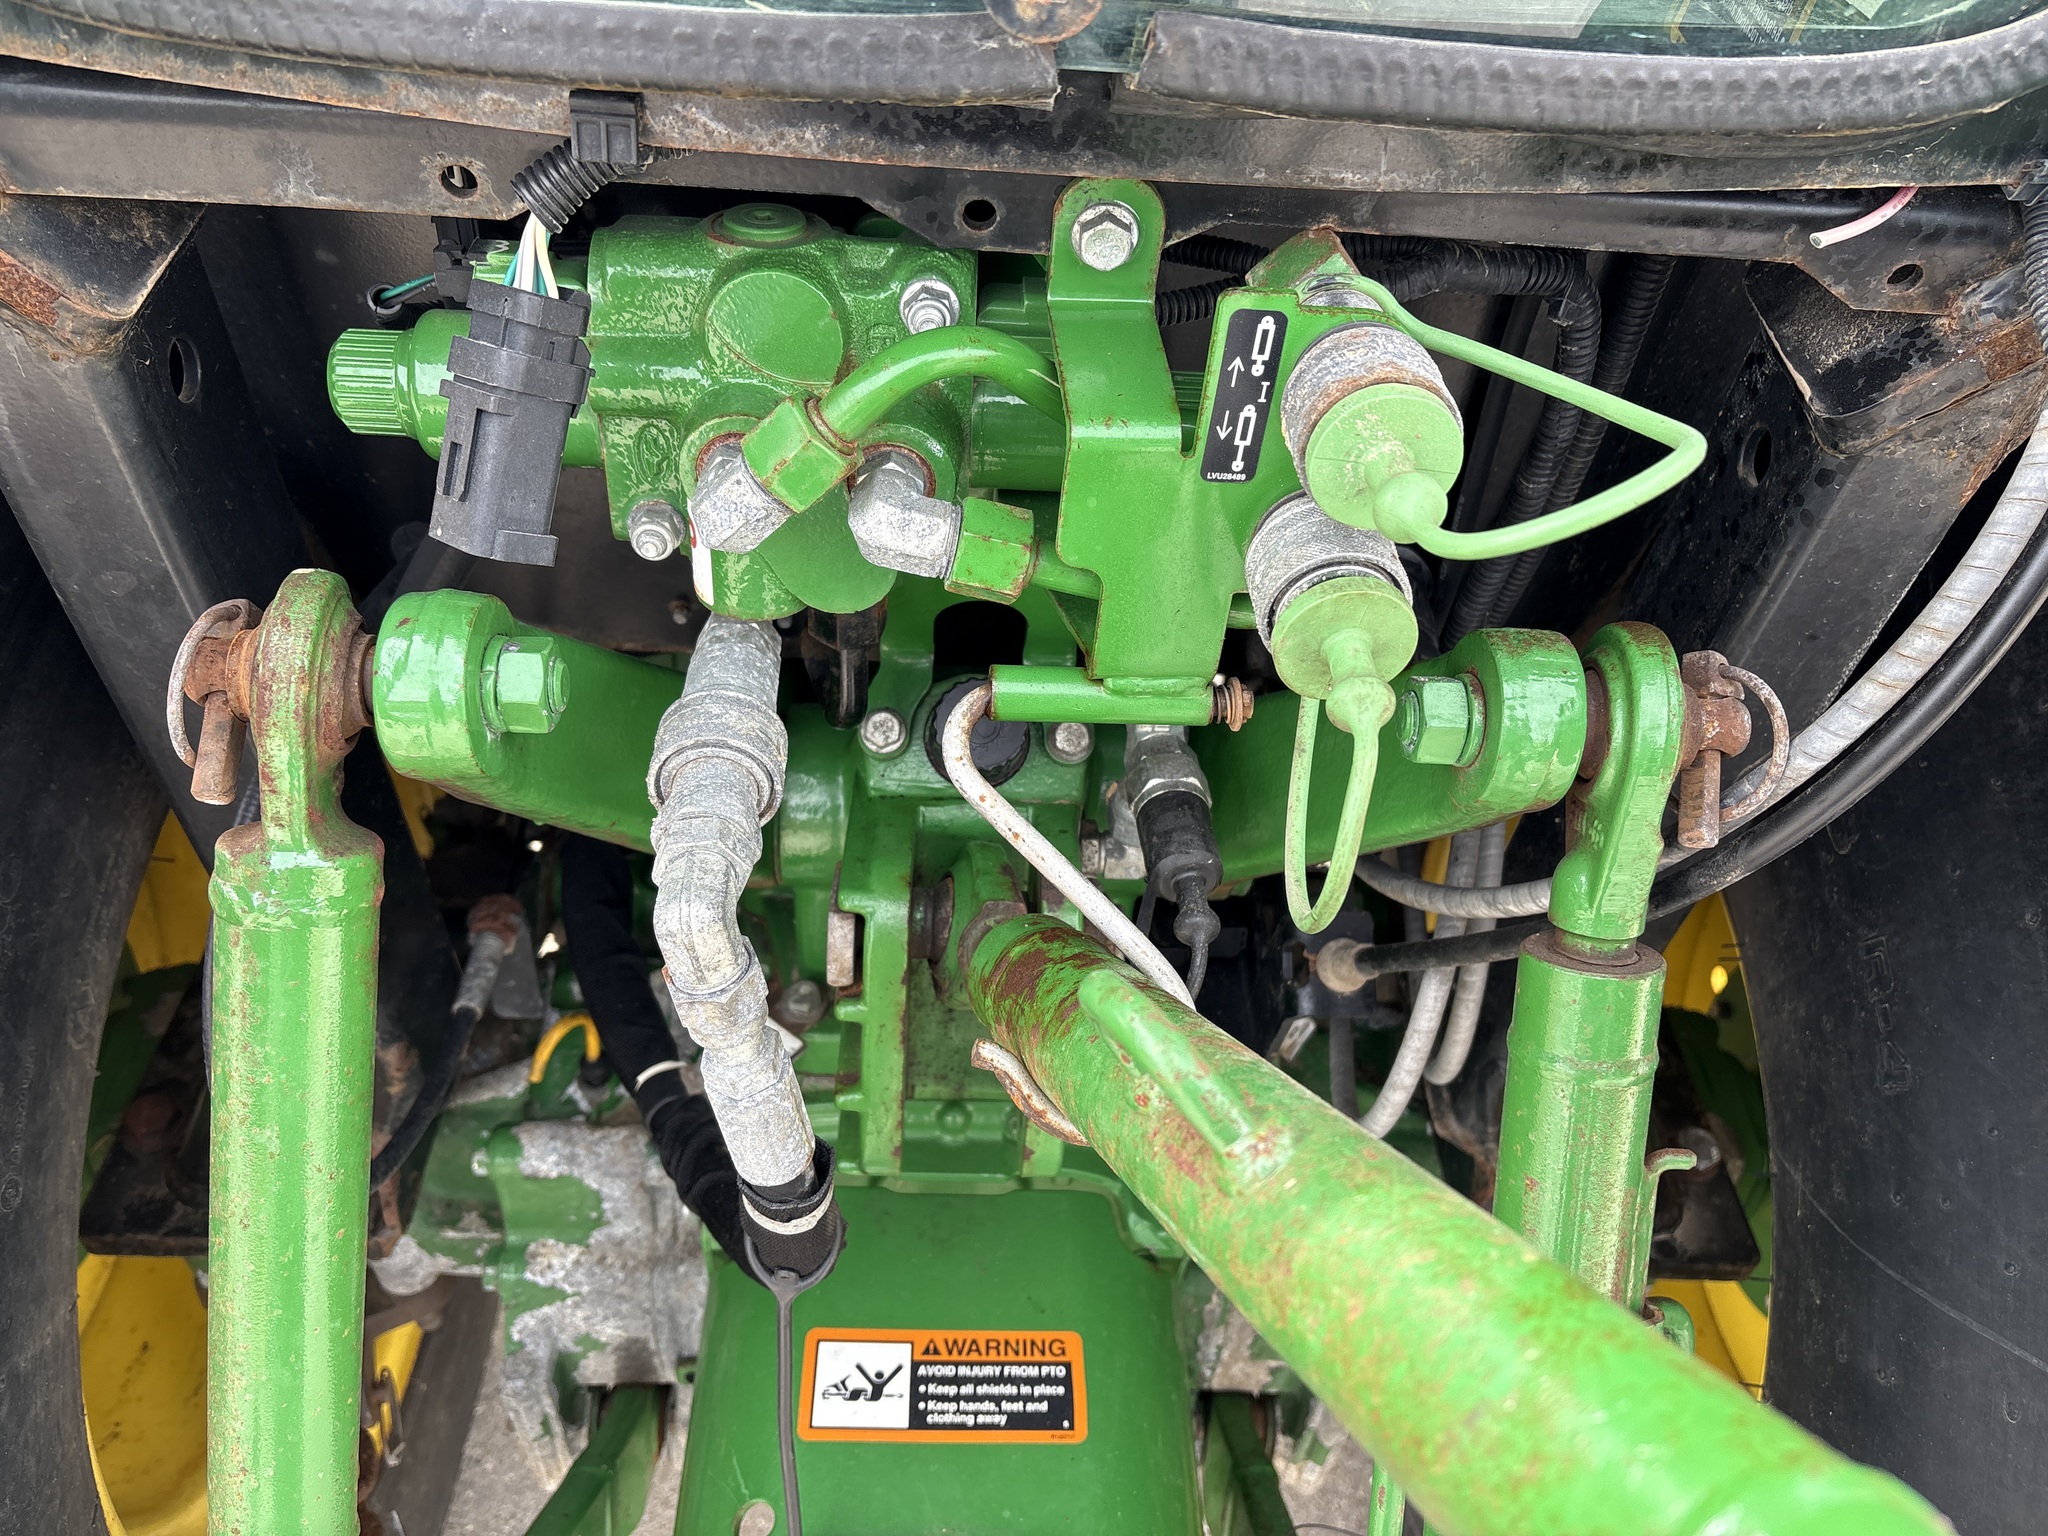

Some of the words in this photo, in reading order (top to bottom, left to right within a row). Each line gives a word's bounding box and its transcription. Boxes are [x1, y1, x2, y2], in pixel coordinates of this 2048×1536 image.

[1207, 472, 1246, 480] LVU28489
[944, 1338, 1066, 1357] WARNING
[917, 1365, 957, 1378] AVOID
[957, 1365, 1002, 1378] INJURY
[1003, 1366, 1040, 1378] FROM
[1040, 1366, 1067, 1378] PTO
[927, 1383, 958, 1398] Keep
[959, 1384, 974, 1396] all
[975, 1384, 1019, 1396] shields
[1019, 1384, 1032, 1396] in
[1033, 1384, 1066, 1398] place
[927, 1400, 958, 1413] Keep
[959, 1400, 999, 1413] hands,
[1000, 1400, 1024, 1413] feet
[1025, 1400, 1049, 1413] and
[926, 1413, 975, 1427] clothing
[976, 1415, 1008, 1427] away
